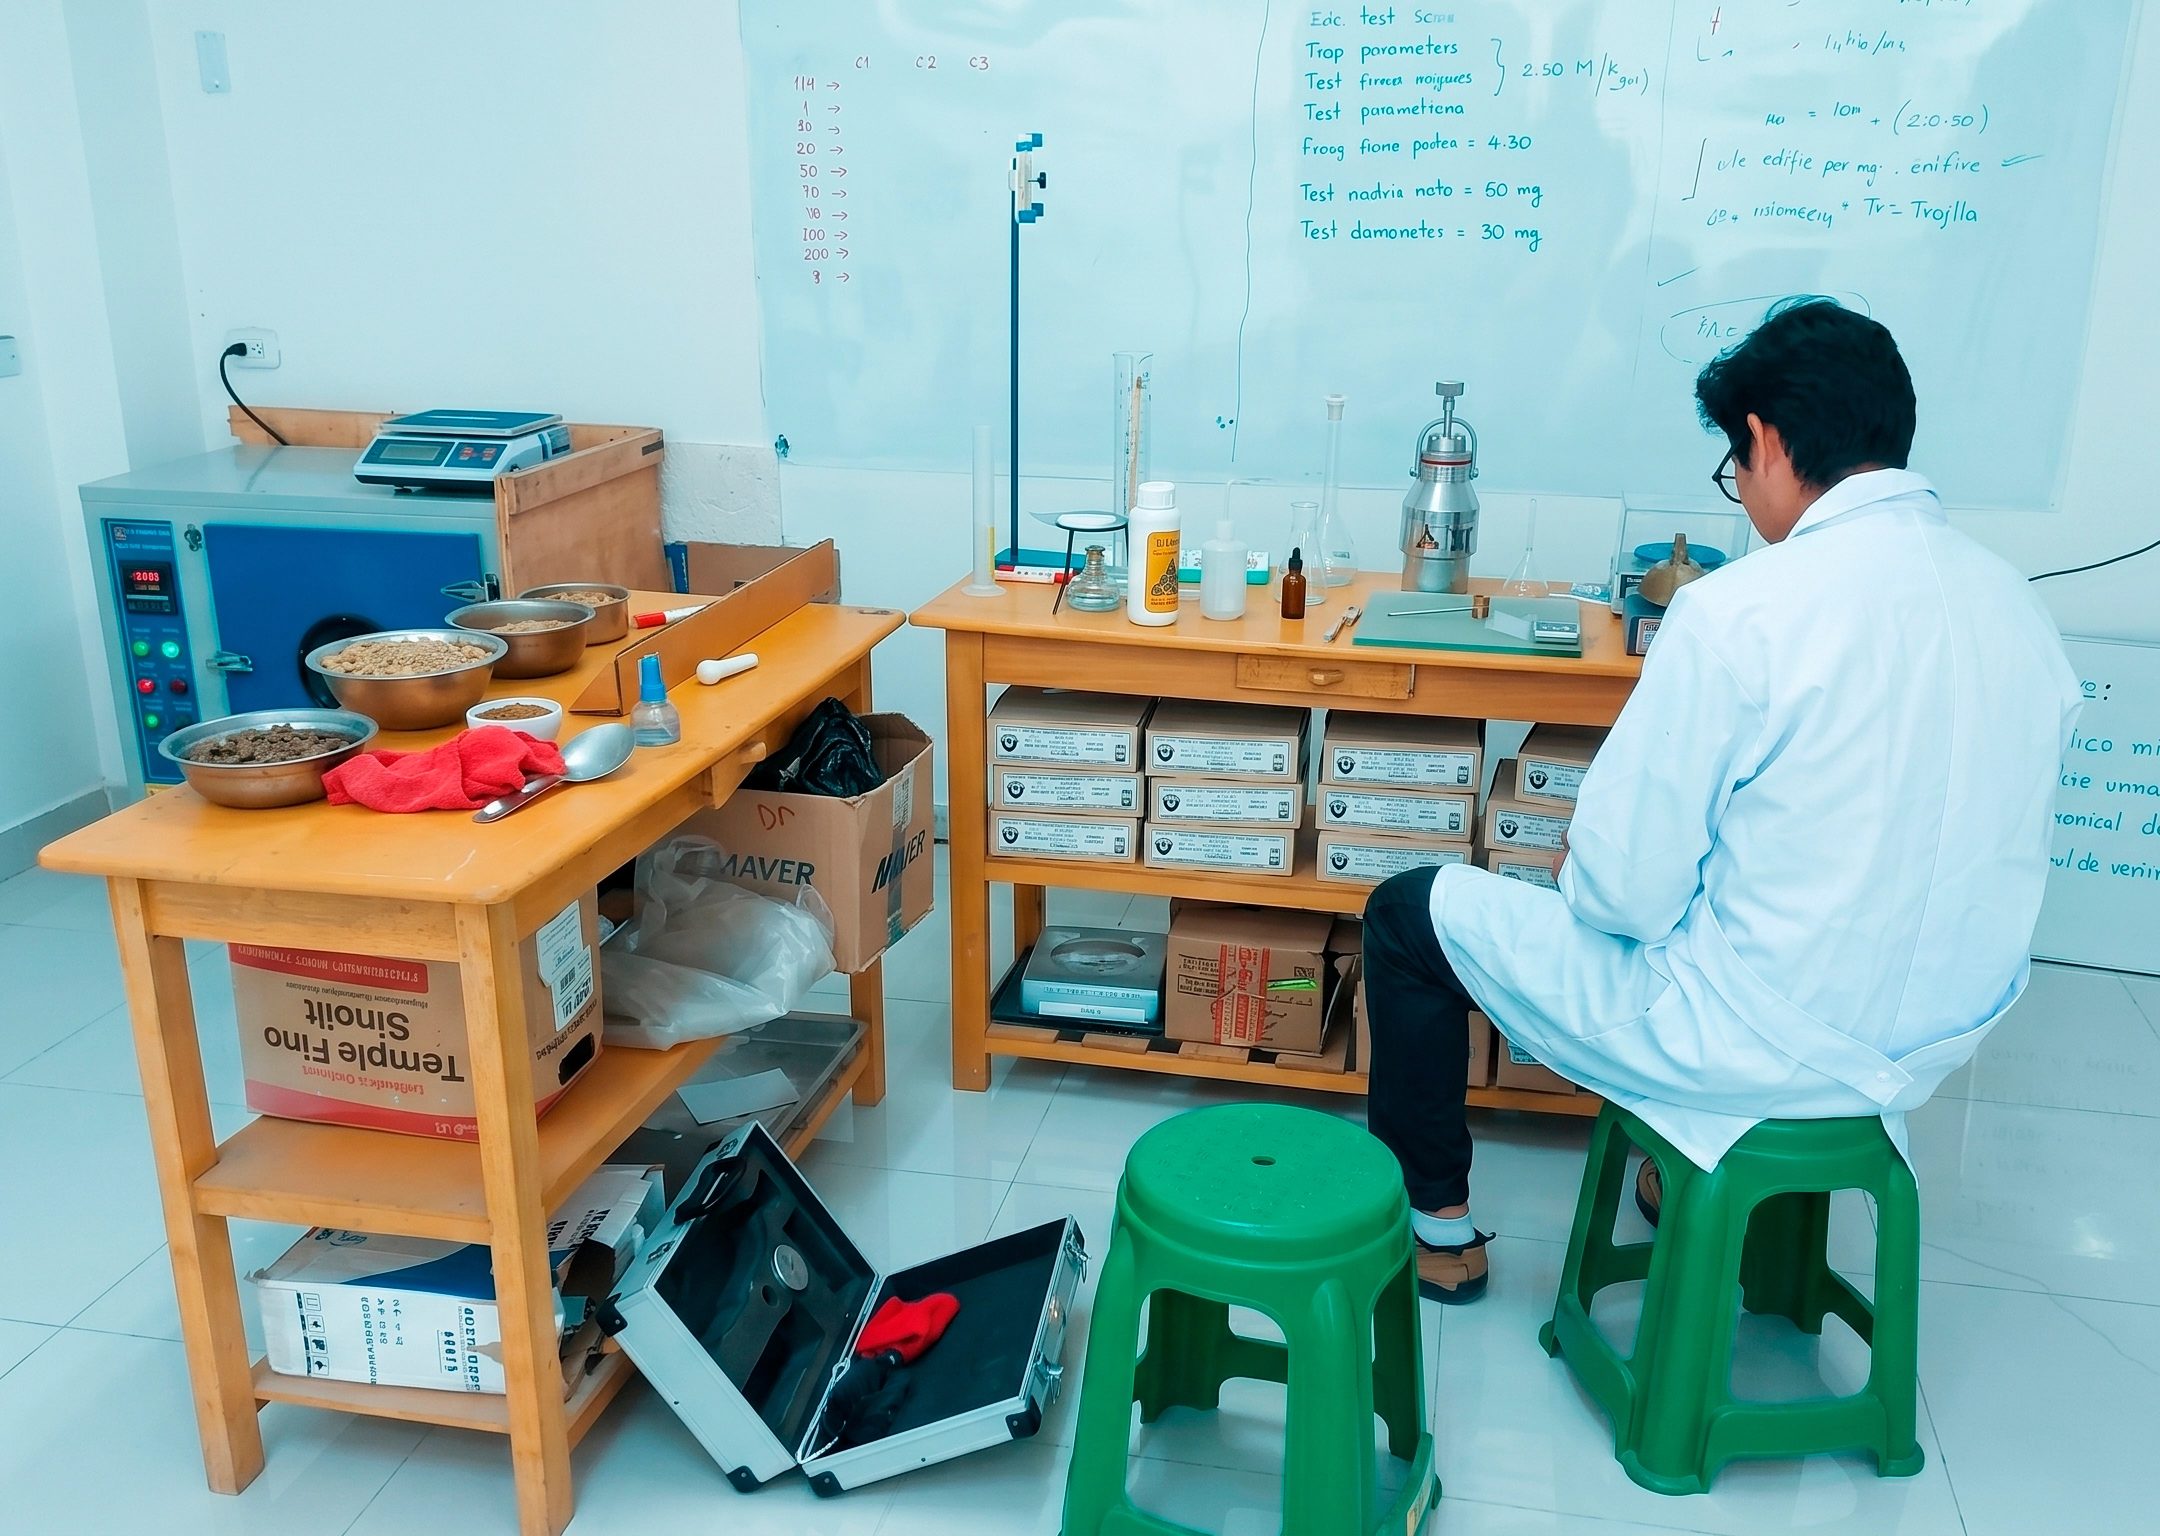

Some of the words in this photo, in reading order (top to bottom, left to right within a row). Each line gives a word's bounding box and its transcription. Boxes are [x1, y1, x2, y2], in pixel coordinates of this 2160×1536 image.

[1360, 5, 1395, 26] test
[1305, 42, 1344, 63] Trop
[855, 56, 869, 69] C1
[969, 56, 989, 70] C3
[1522, 62, 1564, 78] 2.50
[1304, 72, 1342, 91] Test
[1304, 101, 1341, 121] Test
[797, 142, 815, 155] 20
[1488, 136, 1532, 151] 4.30
[800, 164, 817, 178] 50
[1822, 160, 1850, 179] per
[1300, 183, 1335, 201] Test
[1485, 182, 1508, 198] 50
[1517, 185, 1544, 208] mg
[1300, 219, 1338, 239] Test
[1350, 219, 1444, 240] damonetes
[1481, 223, 1505, 240] 30
[1514, 228, 1543, 252] mg
[804, 247, 829, 261] 200
[305, 998, 410, 1041] Sinoilt
[264, 1026, 331, 1064] Fino
[338, 1041, 465, 1082] Temple
